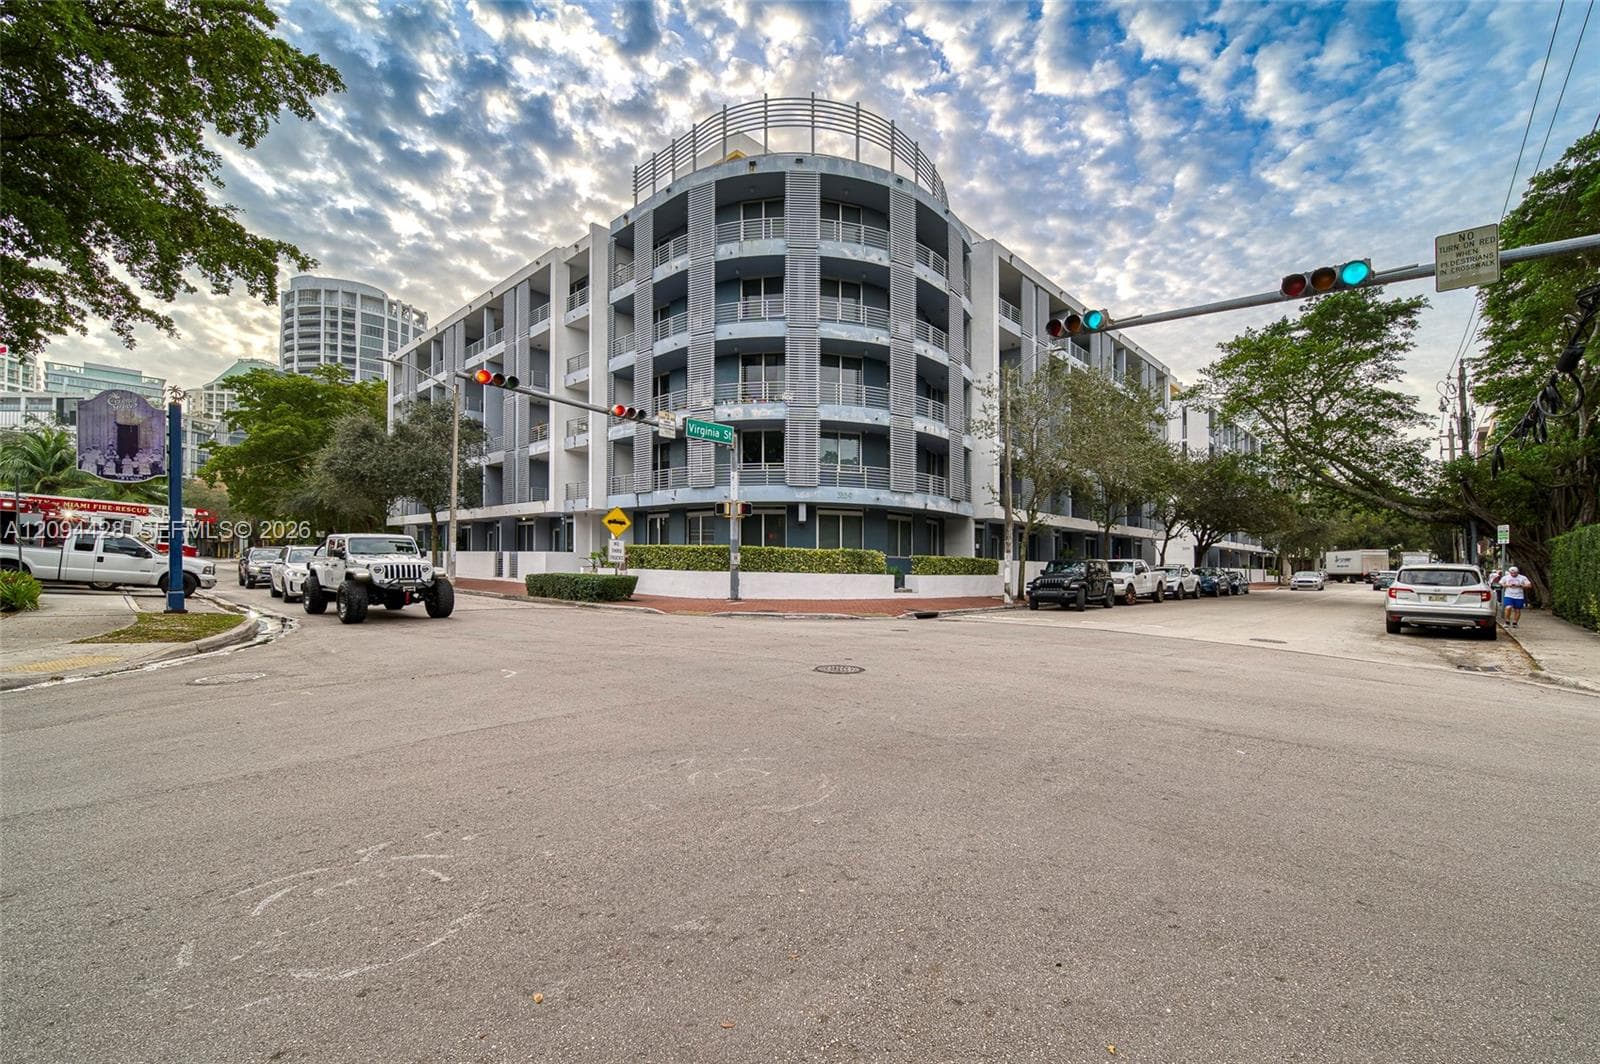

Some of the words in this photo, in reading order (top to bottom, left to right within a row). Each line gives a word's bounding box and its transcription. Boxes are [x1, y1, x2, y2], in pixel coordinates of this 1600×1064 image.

[1458, 231, 1474, 242] NO
[1439, 243, 1459, 254] TURN
[1463, 240, 1475, 249] ON
[1479, 236, 1496, 246] RED
[1440, 252, 1494, 268] PEDESTRIANS
[1456, 248, 1478, 258] WHEN
[1450, 259, 1495, 274] CROSSWALK
[688, 423, 720, 438] Virginia
[723, 429, 732, 440] St
[63, 501, 91, 510] MIAMI
